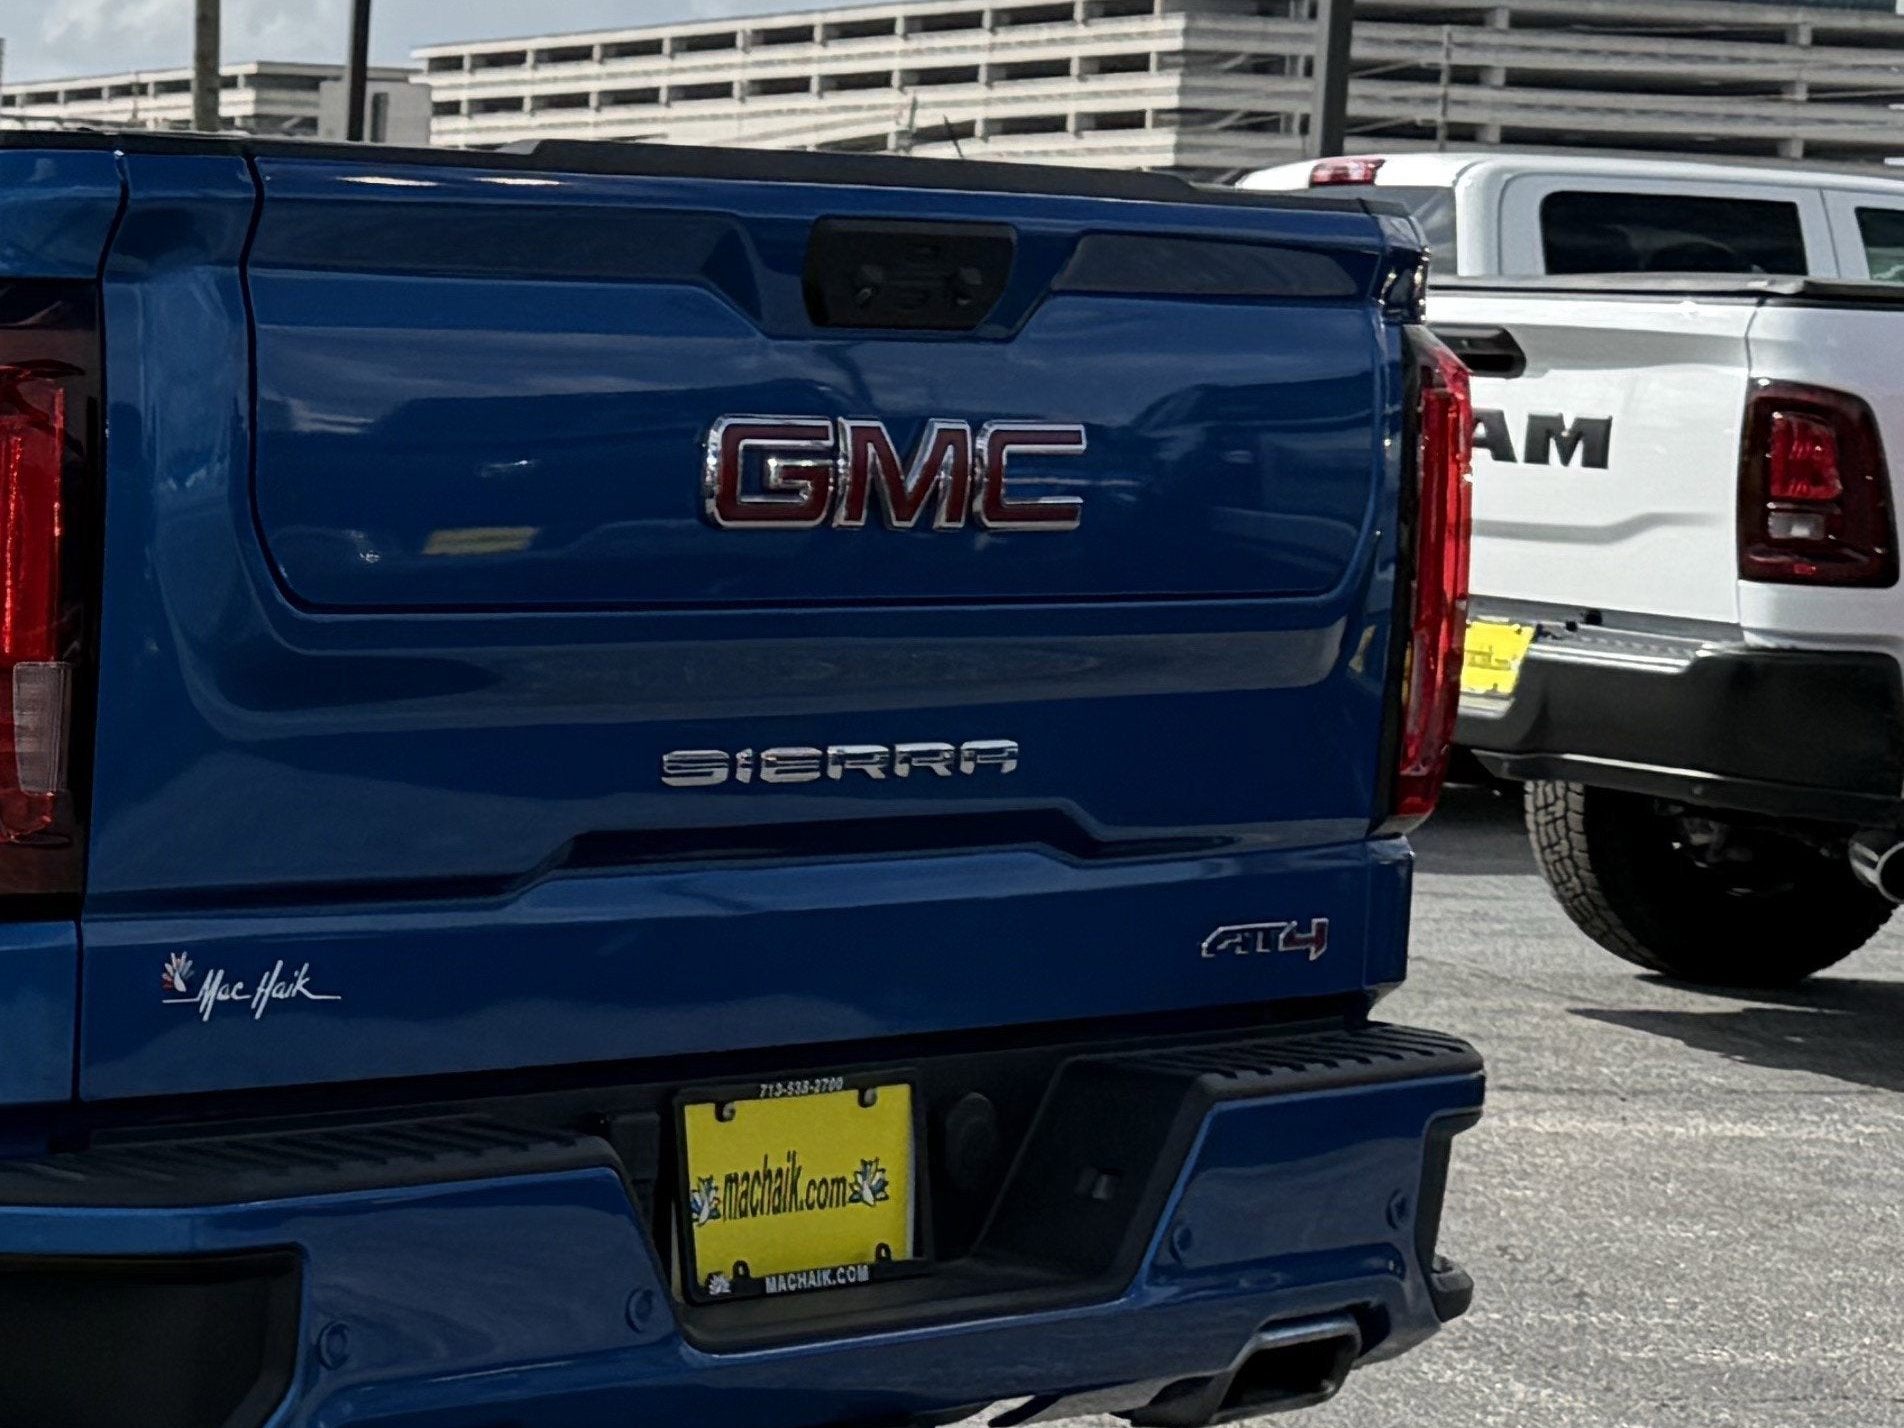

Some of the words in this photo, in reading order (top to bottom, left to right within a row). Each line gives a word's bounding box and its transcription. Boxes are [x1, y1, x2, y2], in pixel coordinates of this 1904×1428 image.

[1471, 408, 1613, 469] AM
[703, 414, 1087, 530] GMC
[661, 739, 1019, 787] SIERRA
[1201, 917, 1329, 961] AT4
[162, 969, 252, 1022] Mac
[251, 960, 341, 1020] Haik
[722, 1149, 848, 1223] machaik.com
[765, 1264, 870, 1294] MACHAIK.COM
